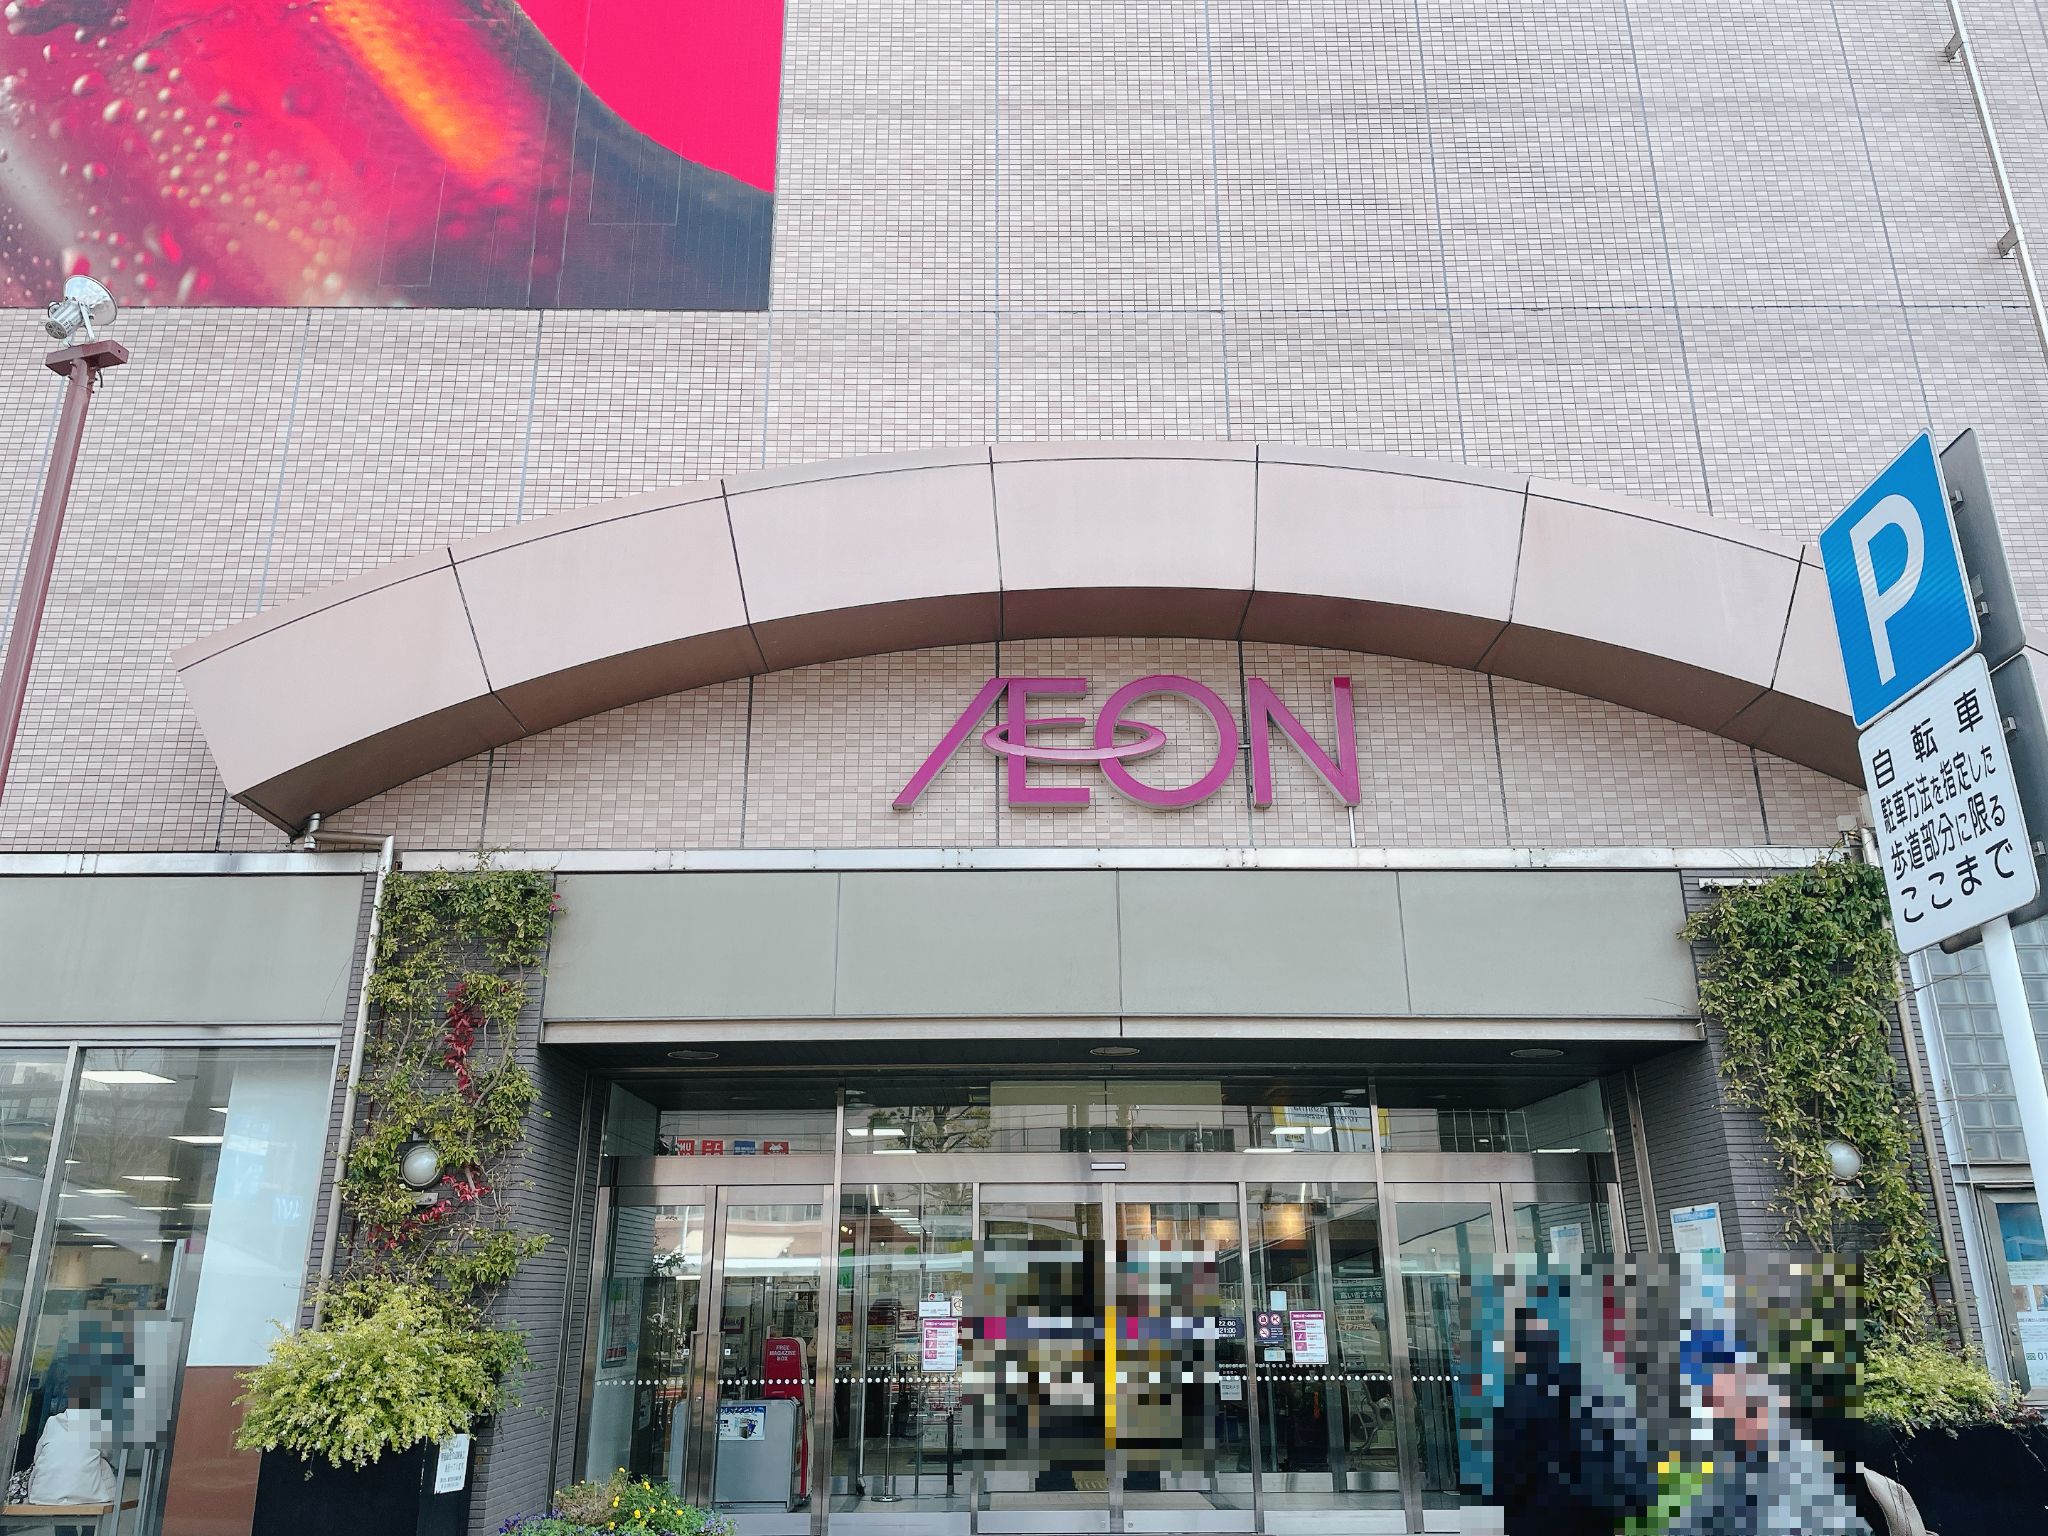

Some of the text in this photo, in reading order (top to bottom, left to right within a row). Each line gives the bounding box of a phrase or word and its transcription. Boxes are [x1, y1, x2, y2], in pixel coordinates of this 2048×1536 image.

[1849, 493, 1925, 686] P
[1872, 688, 1984, 789] 自転車
[1880, 745, 1996, 833] 駐車方法を指定した
[1891, 792, 2006, 880] 歩道部分に限る
[1901, 838, 2015, 923] ここまで
